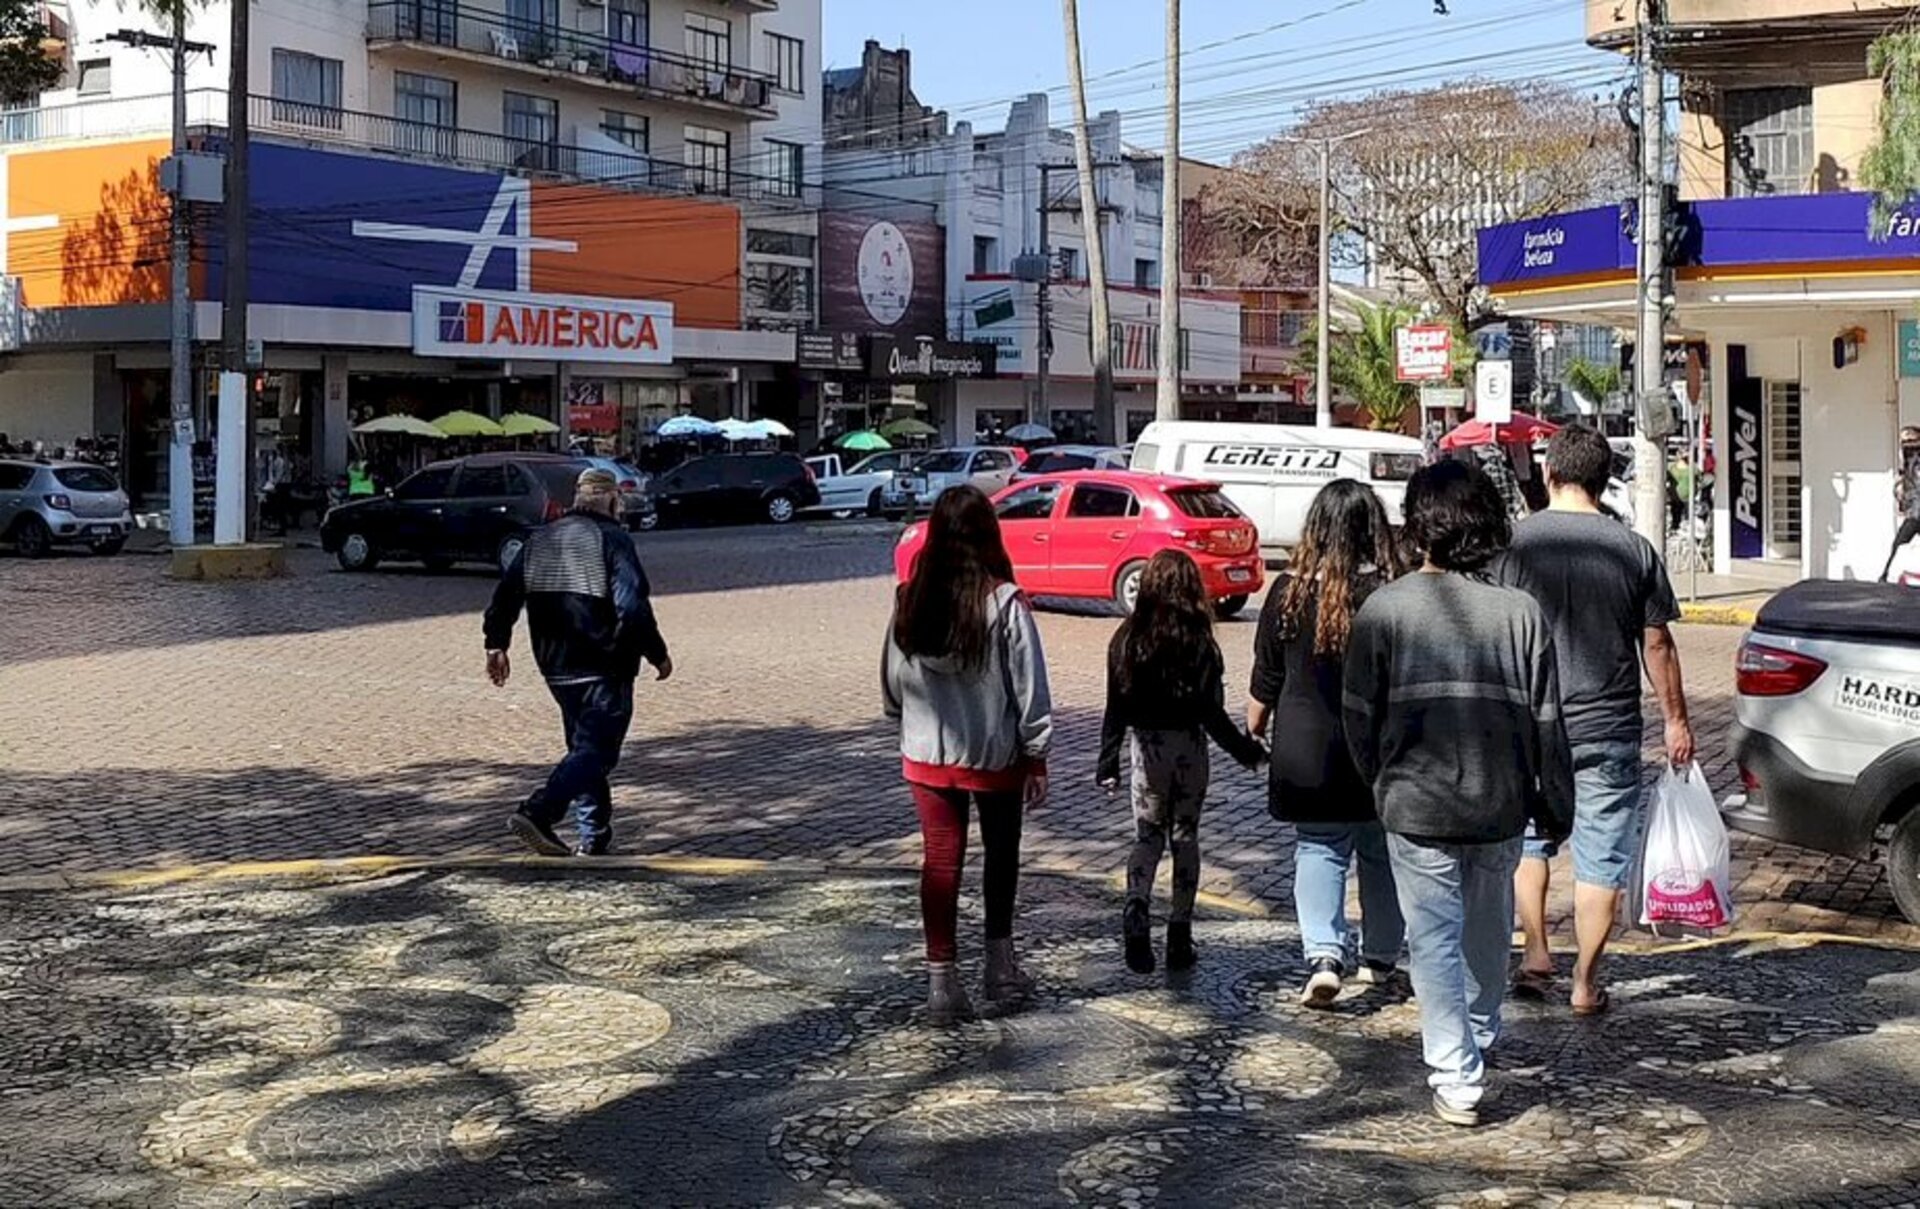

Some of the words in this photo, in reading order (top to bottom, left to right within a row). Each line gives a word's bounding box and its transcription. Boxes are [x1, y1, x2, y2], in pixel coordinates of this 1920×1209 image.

[490, 306, 658, 350] AMÉRICA
[1489, 378, 1498, 394] E
[1204, 445, 1341, 469] CERETTA
[1735, 406, 1757, 528] PanVel
[1844, 677, 1920, 708] HARD
[1842, 694, 1919, 720] WORKING
